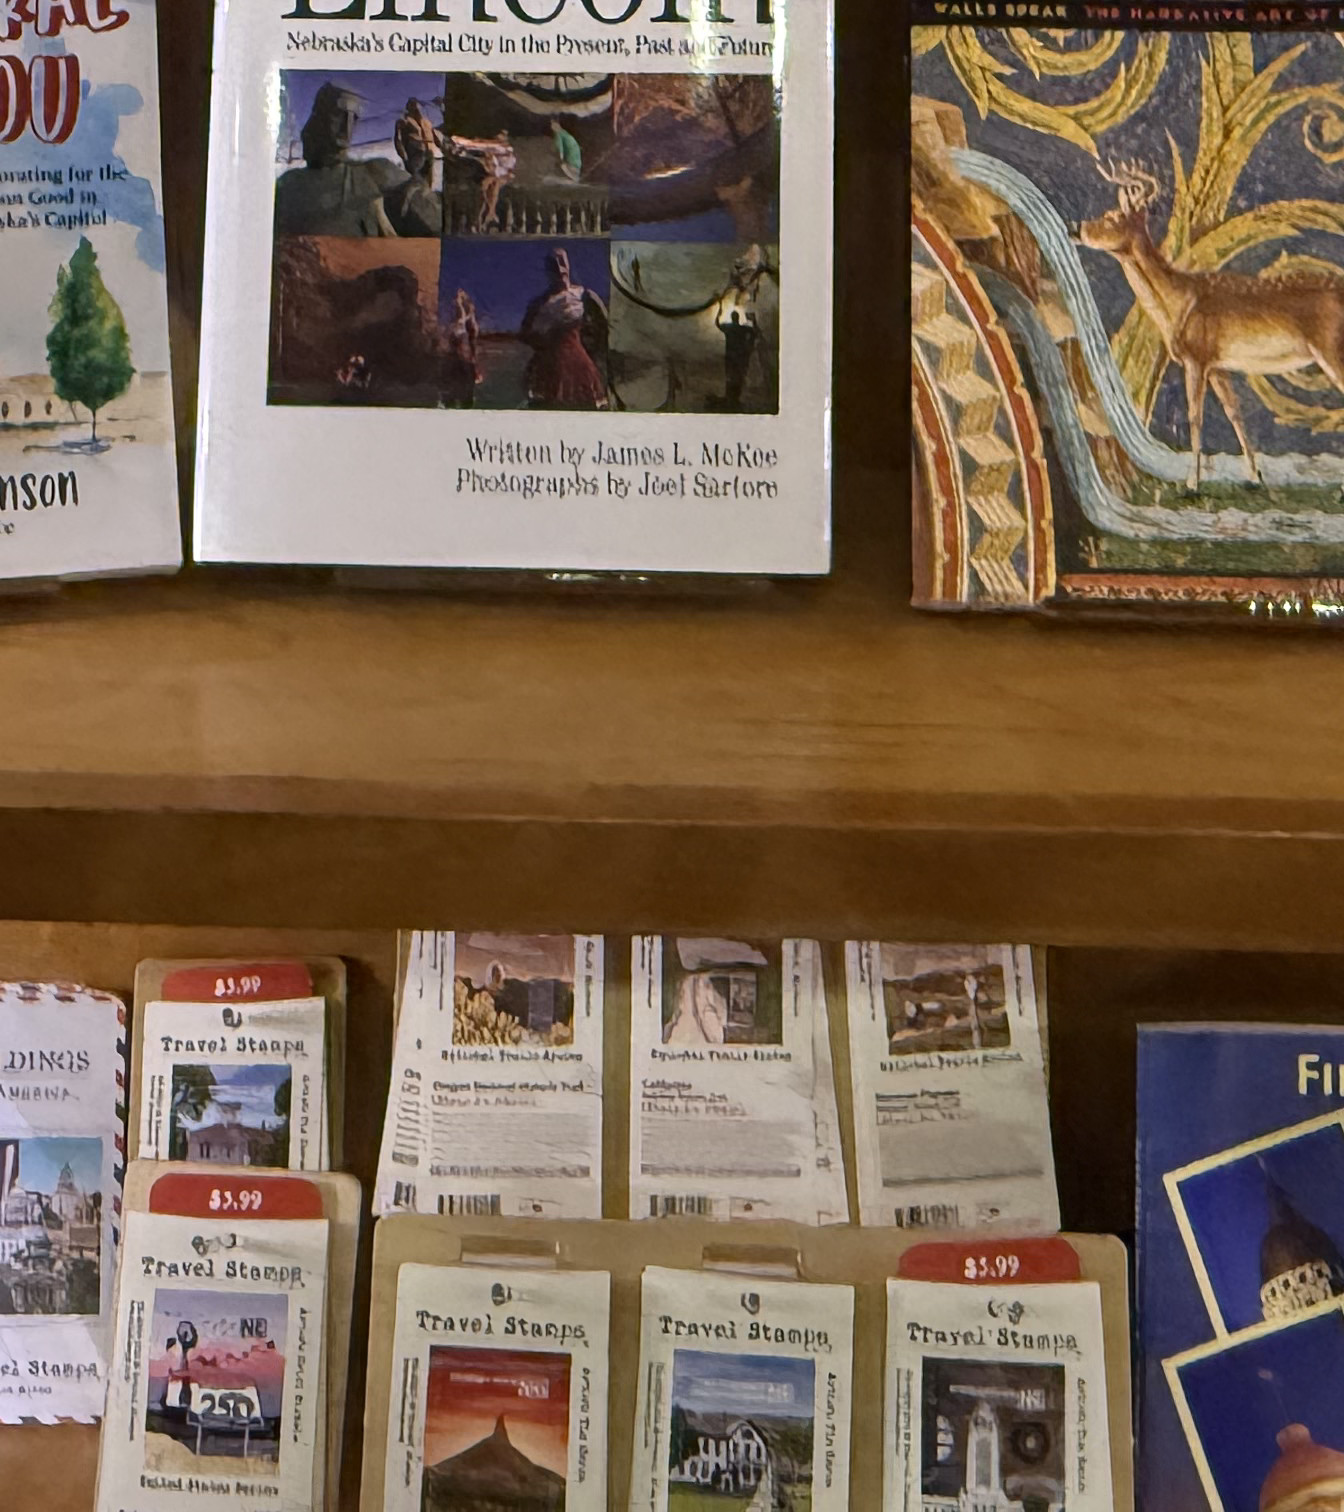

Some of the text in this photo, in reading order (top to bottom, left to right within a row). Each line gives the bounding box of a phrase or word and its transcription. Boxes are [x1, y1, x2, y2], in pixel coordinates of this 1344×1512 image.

[286, 31, 384, 53] Nebraska's
[521, 32, 550, 54] the
[560, 438, 585, 466] by
[673, 441, 694, 467] L.
[160, 1035, 228, 1053] Travel
[141, 1255, 214, 1278] Travel
[416, 1309, 494, 1336] Travel
